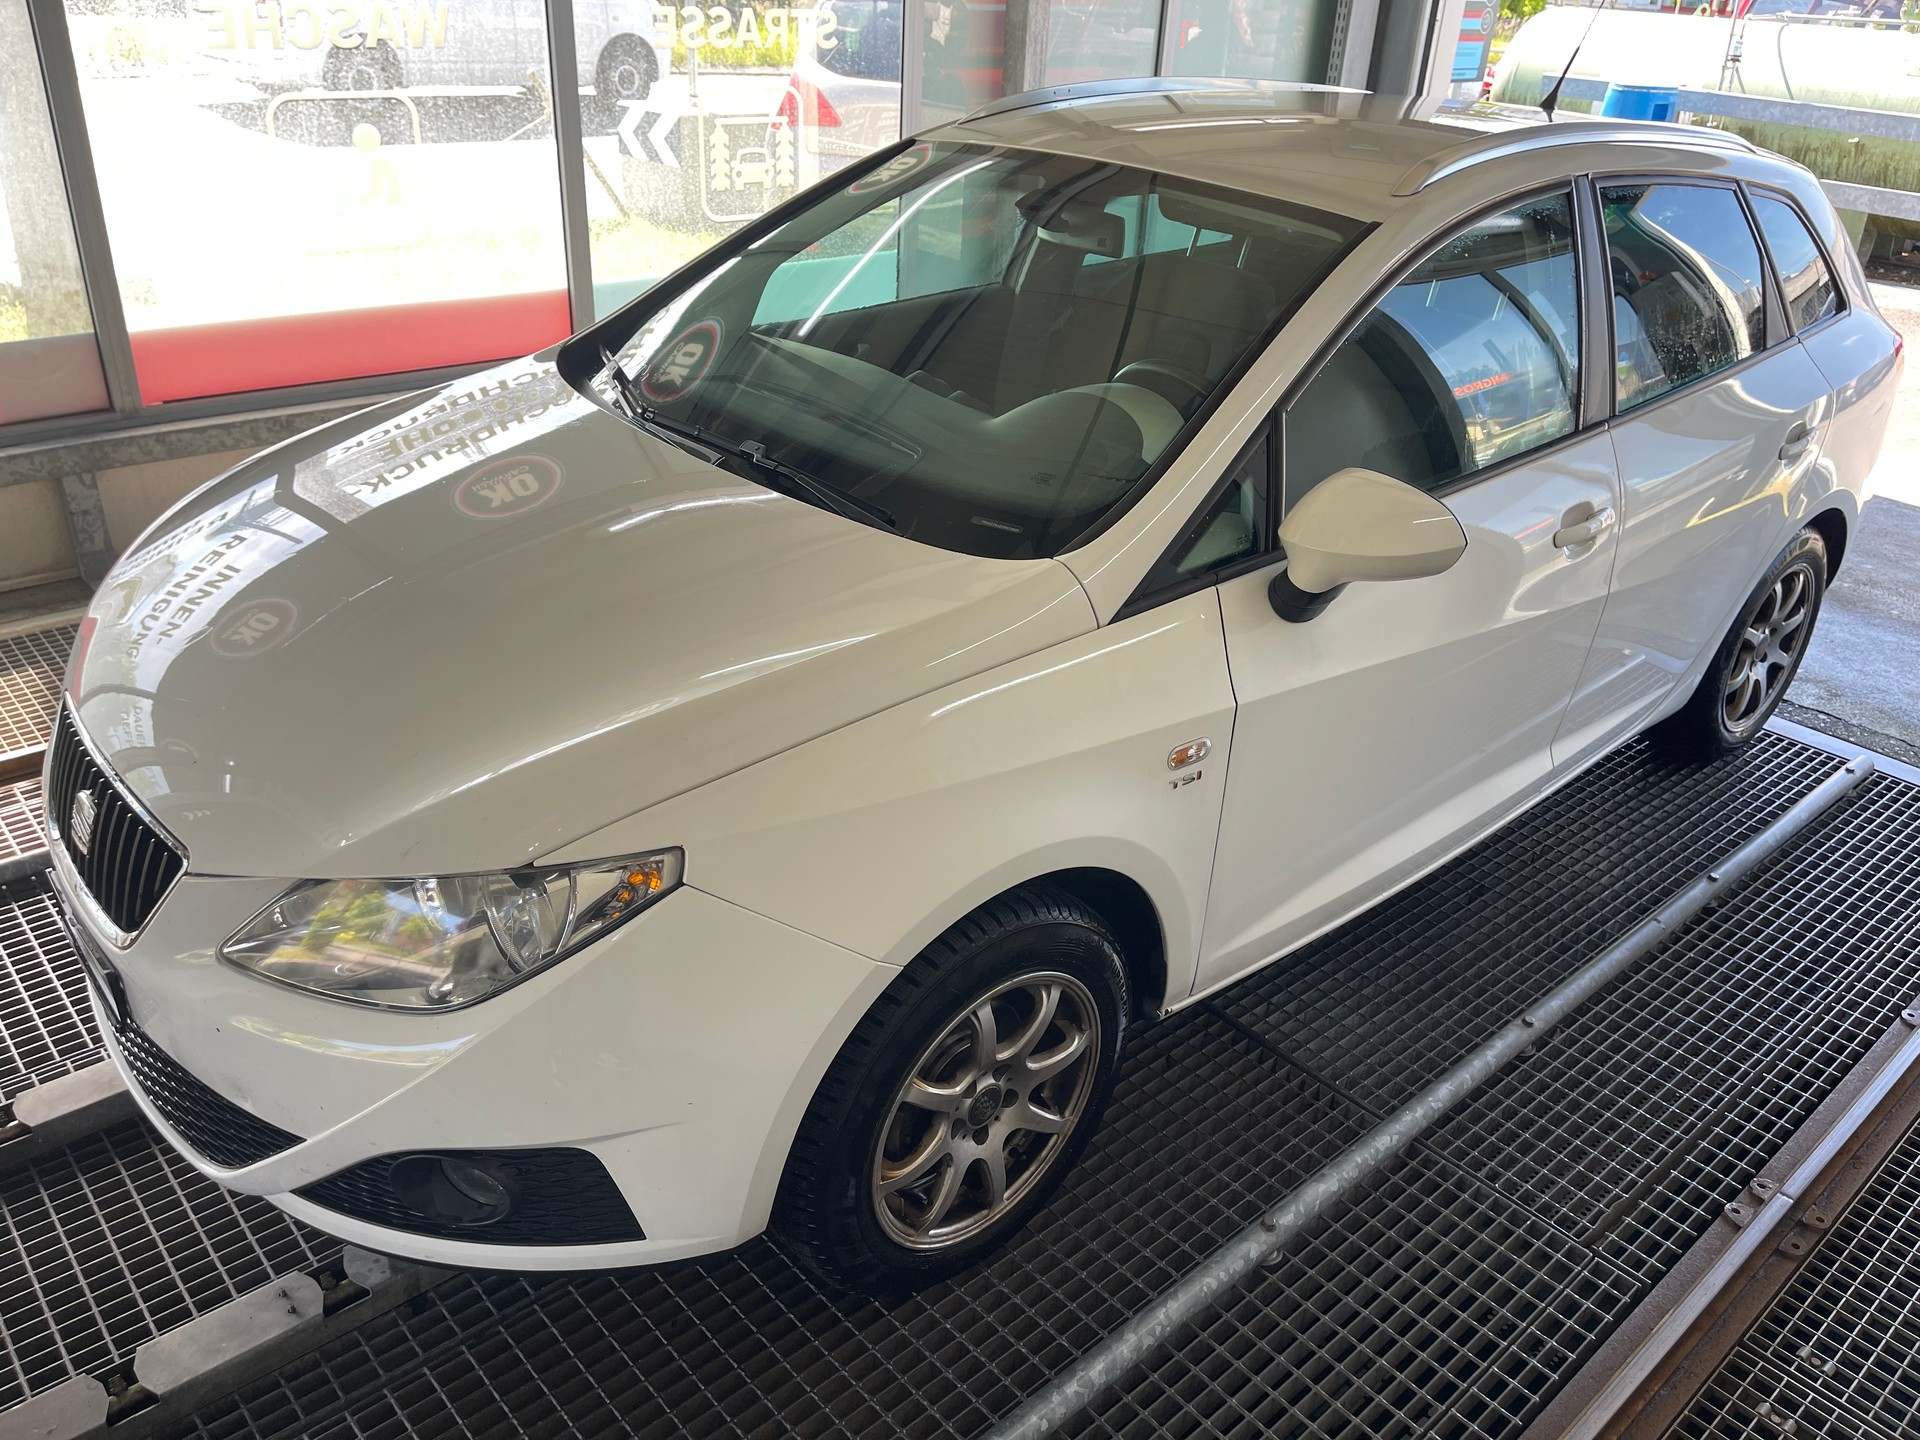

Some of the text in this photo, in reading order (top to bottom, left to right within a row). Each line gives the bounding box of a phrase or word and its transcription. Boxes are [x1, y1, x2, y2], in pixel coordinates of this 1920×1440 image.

[658, 342, 704, 388] OK
[477, 472, 540, 509] OK
[127, 534, 248, 660] REINIGUNG
[156, 563, 242, 645] INNEN-
[229, 611, 280, 646] OK
[1168, 769, 1203, 790] TSI
